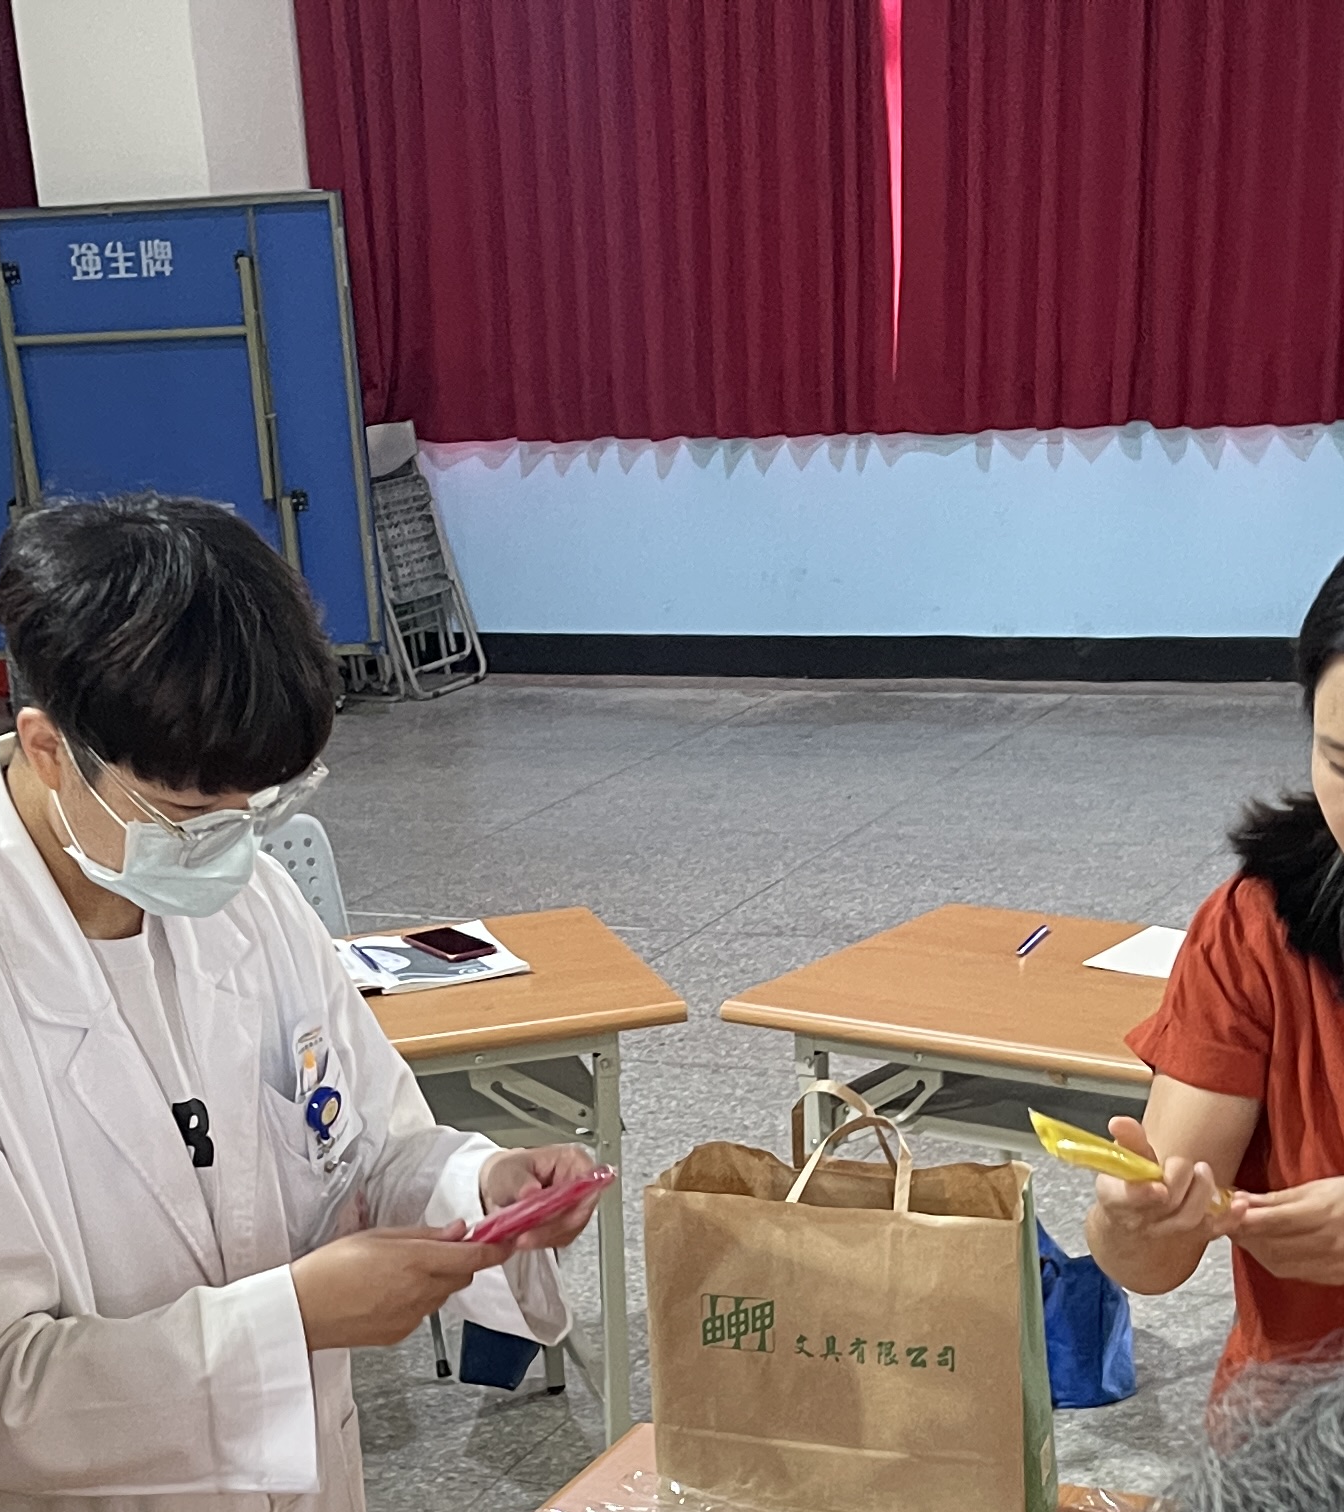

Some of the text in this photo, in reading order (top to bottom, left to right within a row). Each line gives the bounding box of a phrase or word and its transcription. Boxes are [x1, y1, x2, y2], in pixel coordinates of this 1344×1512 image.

[68, 239, 174, 281] 強生牌
[793, 1333, 956, 1373] 文具有限公司
